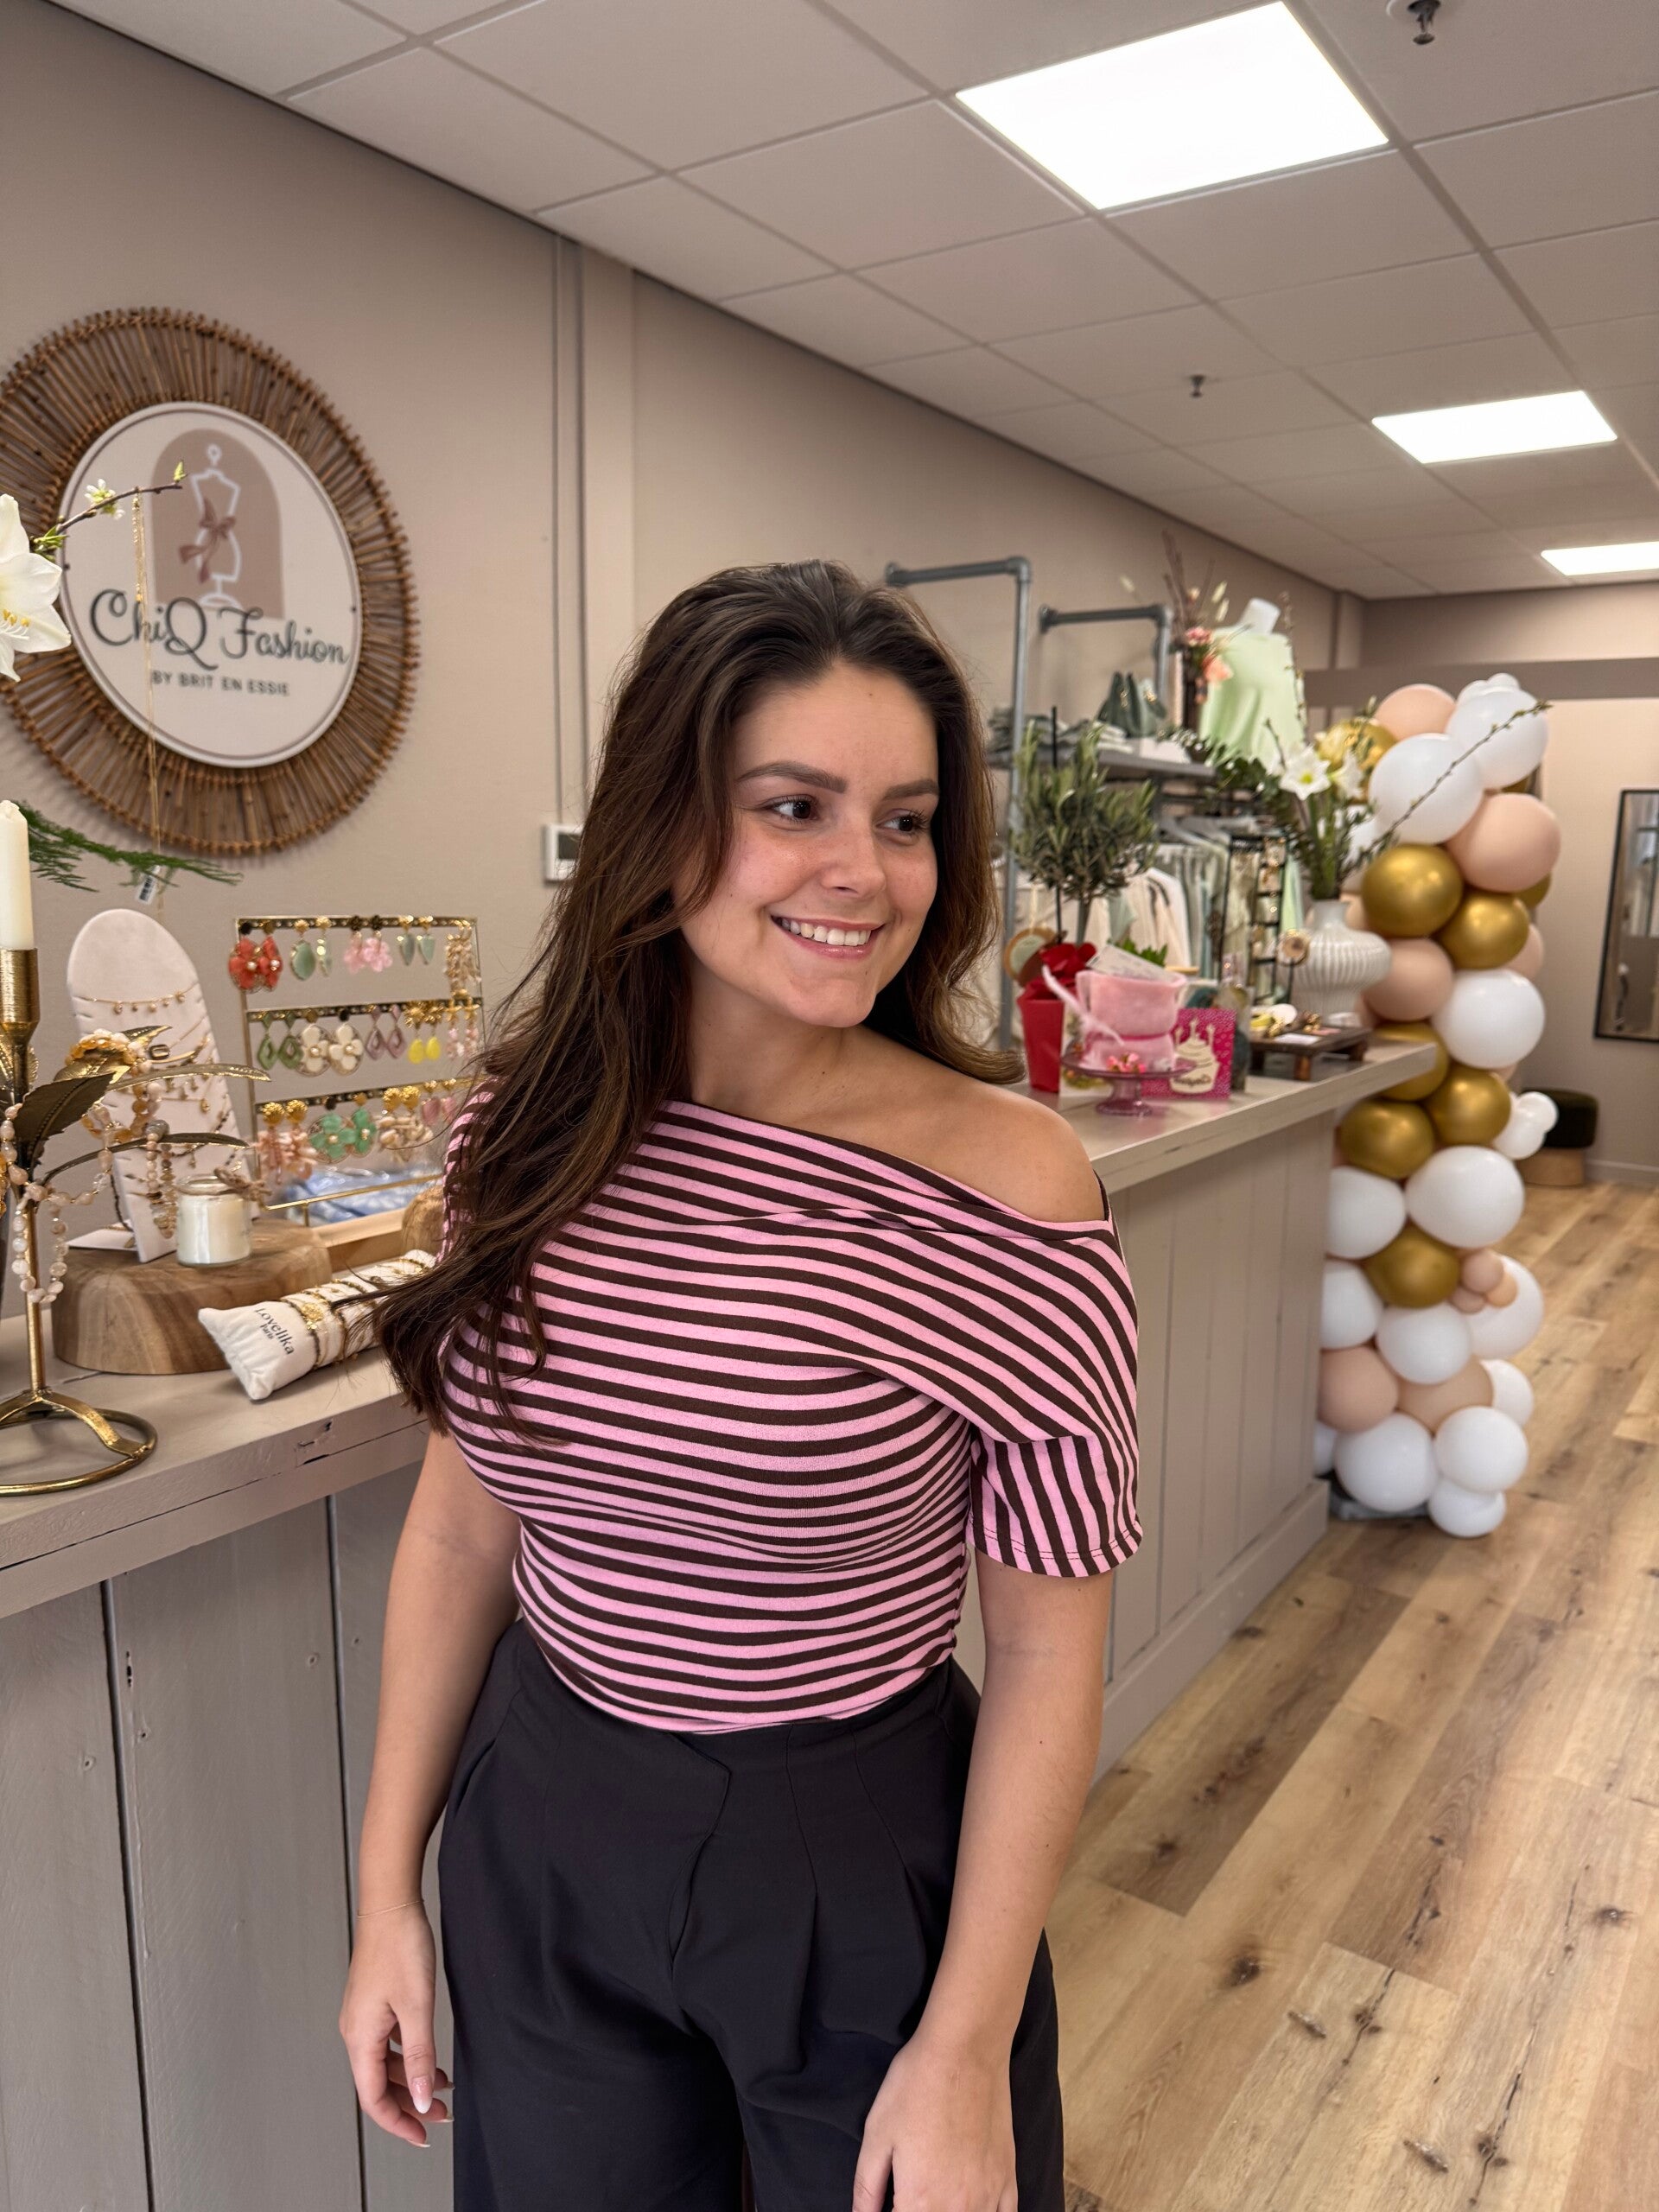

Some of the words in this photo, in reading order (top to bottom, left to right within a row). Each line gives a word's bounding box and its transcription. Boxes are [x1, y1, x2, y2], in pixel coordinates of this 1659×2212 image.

[90, 588, 219, 671] ChiQ
[218, 607, 350, 665] Fashion
[152, 670, 172, 684] BY
[179, 671, 213, 690] BRIT
[221, 676, 243, 691] EN
[247, 678, 289, 696] ESSIE
[255, 1307, 295, 1355] Lovelika
